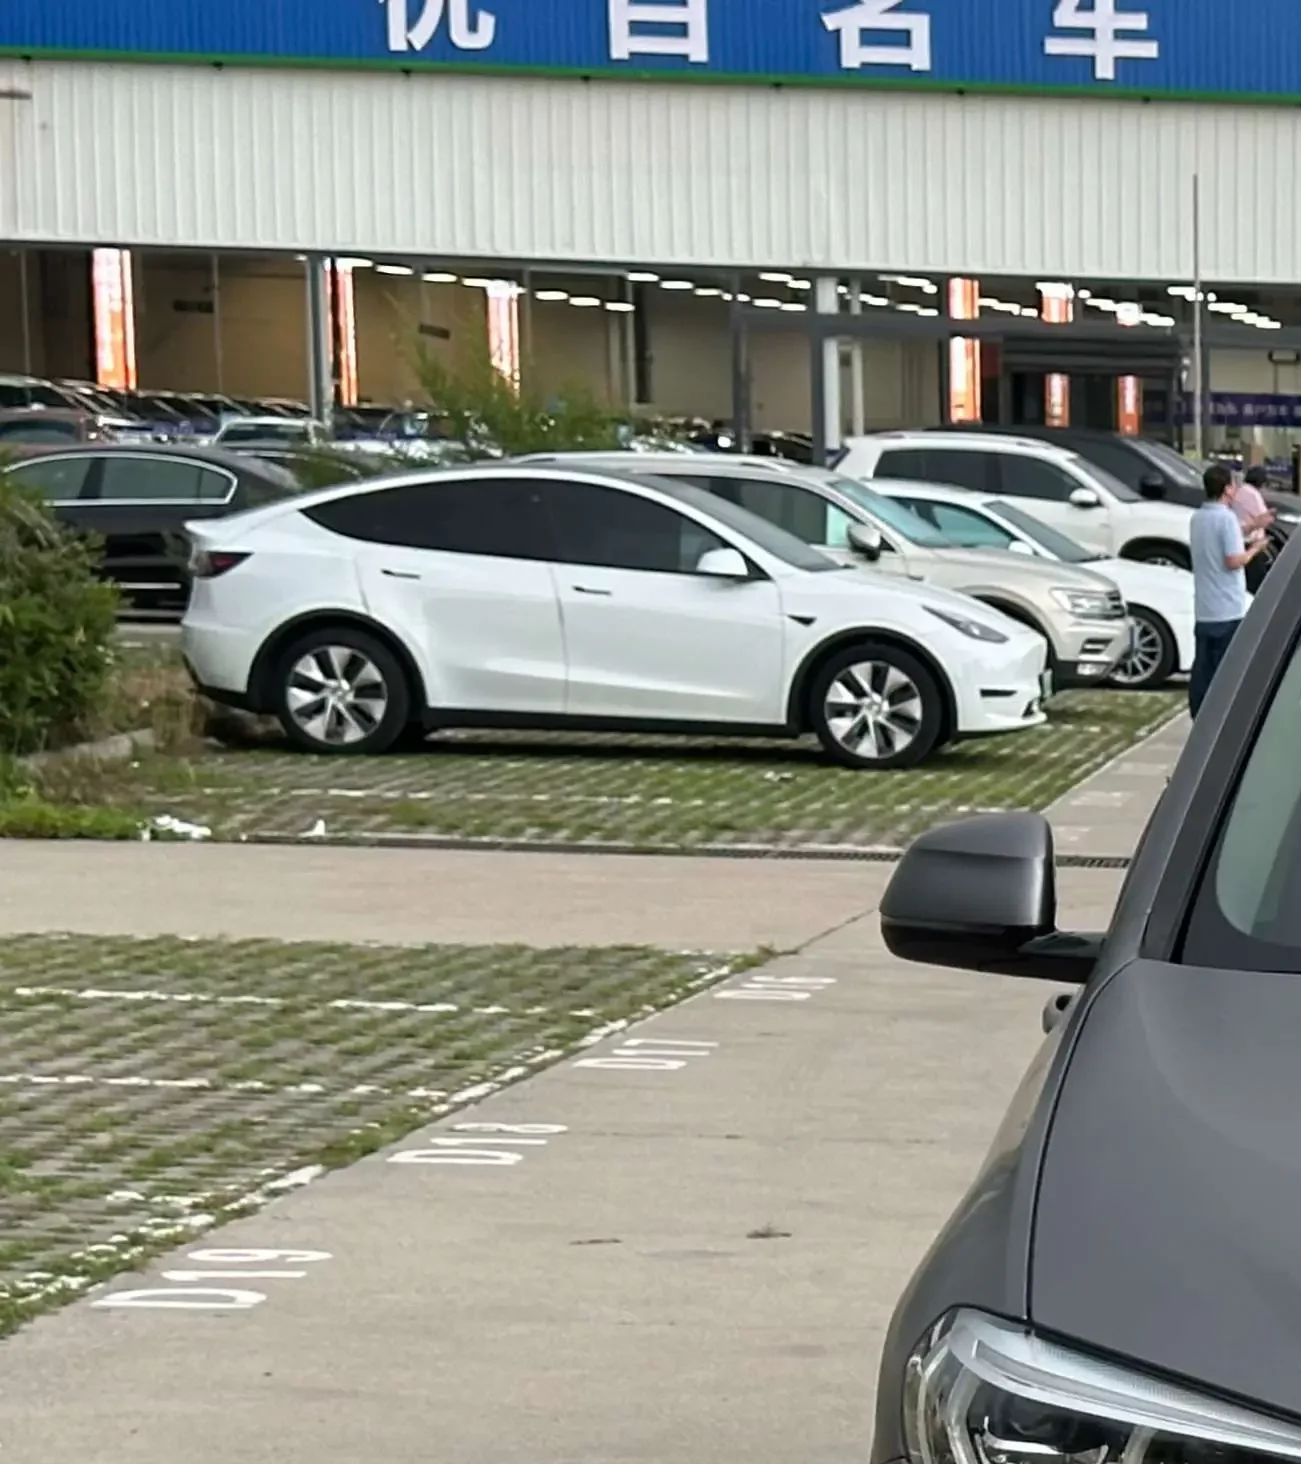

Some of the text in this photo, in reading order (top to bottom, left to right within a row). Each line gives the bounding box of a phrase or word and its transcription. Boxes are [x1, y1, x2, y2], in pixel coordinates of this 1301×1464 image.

[572, 1038, 719, 1070] D17
[386, 1122, 569, 1165] D18
[90, 1248, 334, 1308] D19
